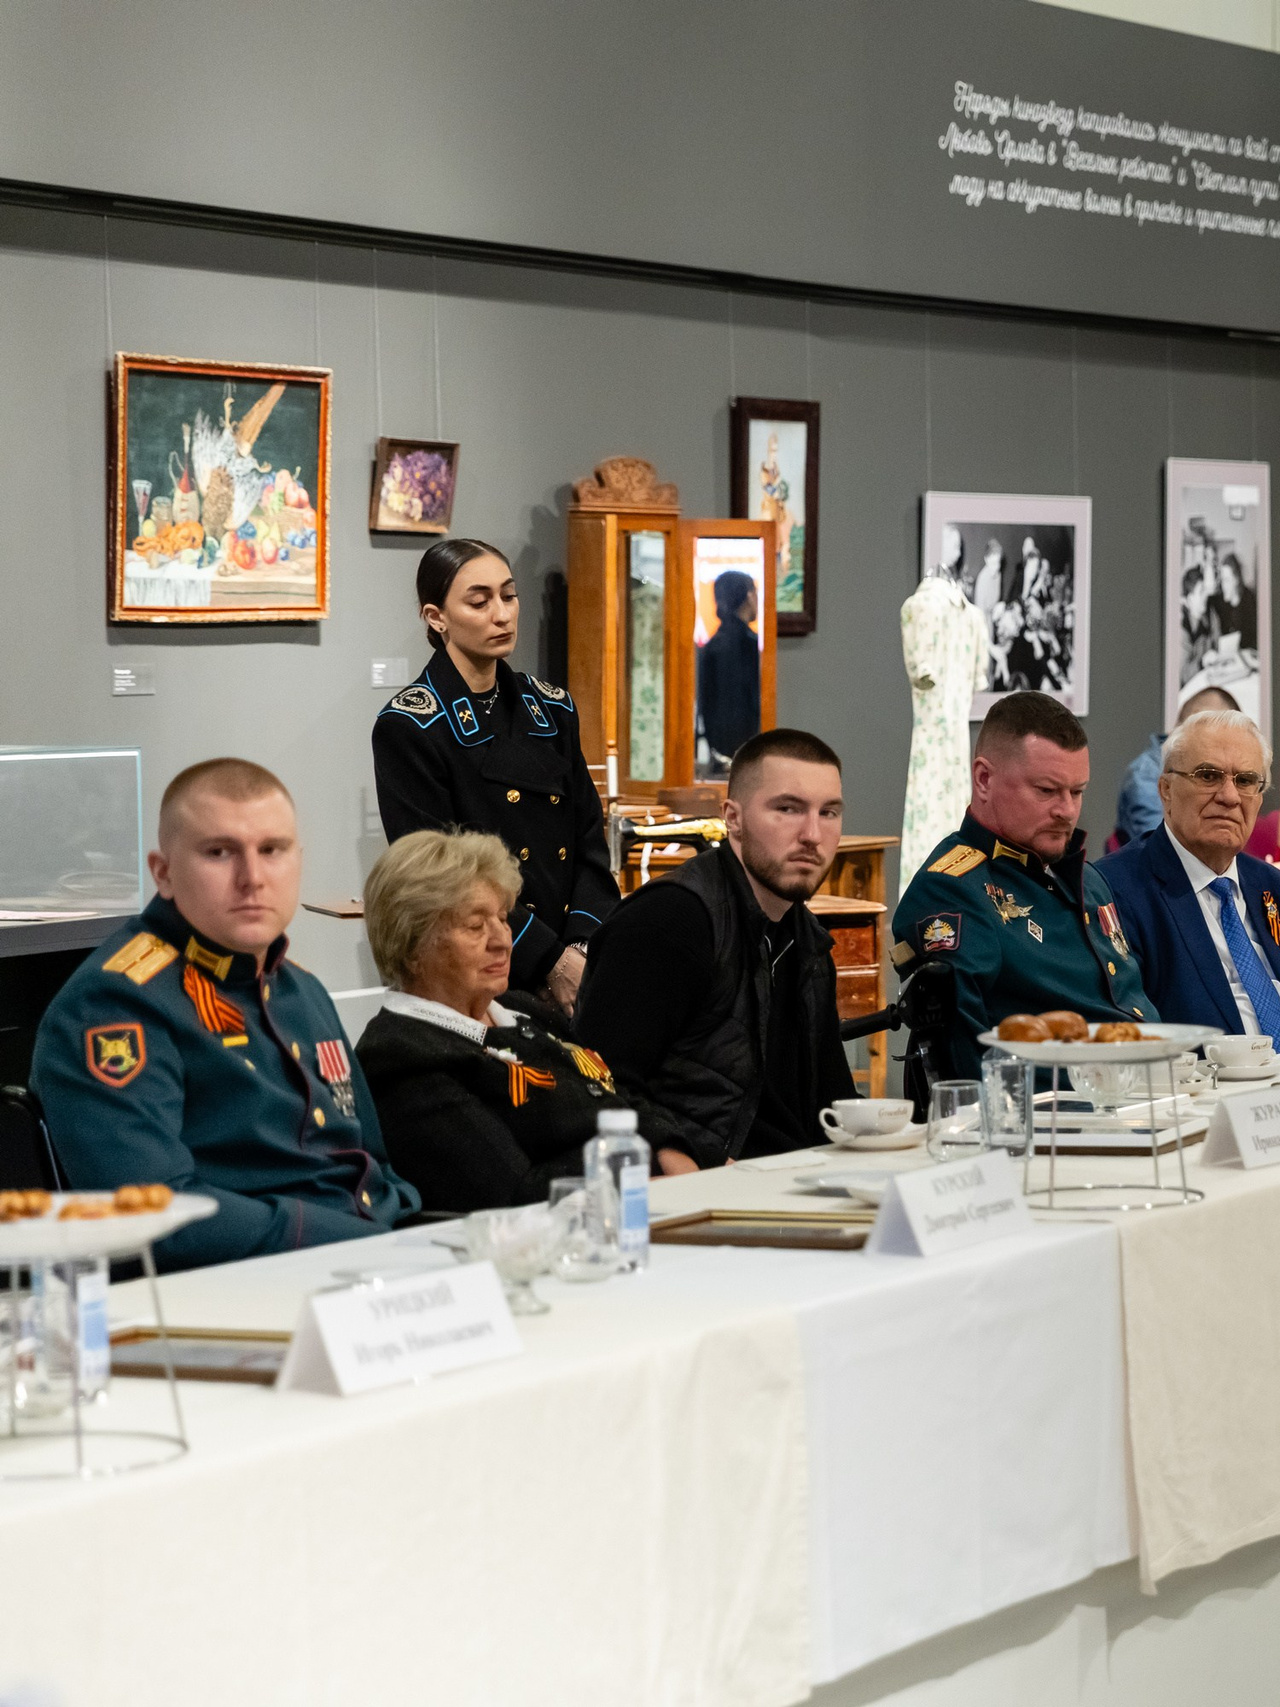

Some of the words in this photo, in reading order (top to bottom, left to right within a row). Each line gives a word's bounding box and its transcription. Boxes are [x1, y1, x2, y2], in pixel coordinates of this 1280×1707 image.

[954, 80, 1011, 125] Наряды
[1228, 137, 1243, 157] по
[1244, 135, 1269, 161] всей
[938, 121, 994, 158] Любовь
[994, 129, 1046, 167] Орлова
[1047, 140, 1058, 166] в
[1177, 167, 1188, 186] и
[949, 174, 986, 207] моду
[987, 179, 1005, 200] на
[1006, 177, 1082, 213] аккуратные
[1083, 187, 1123, 217] волны
[1123, 193, 1134, 218] в
[1183, 206, 1194, 226] и
[932, 1164, 986, 1196] КУРСКИЙ
